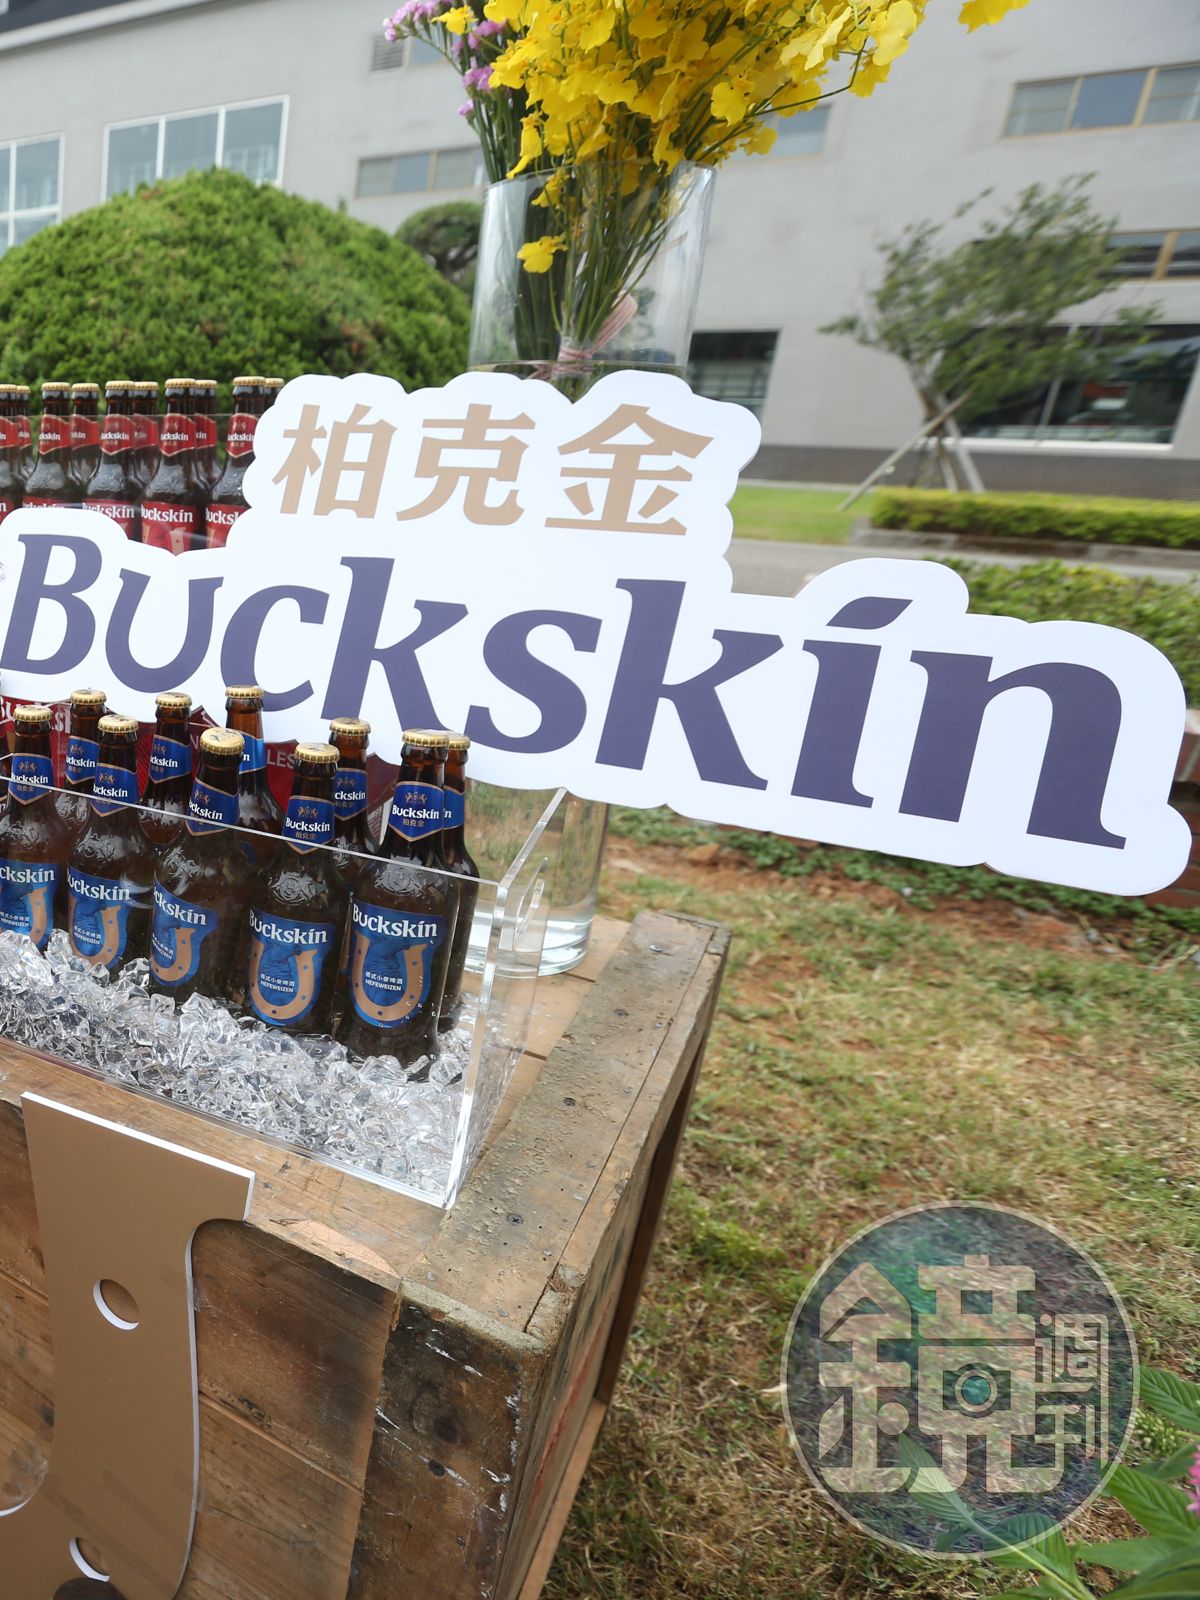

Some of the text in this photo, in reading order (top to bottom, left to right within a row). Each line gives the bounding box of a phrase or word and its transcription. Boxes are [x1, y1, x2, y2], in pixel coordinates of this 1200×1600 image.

[101, 432, 130, 441] uckskin
[160, 432, 189, 441] uckskin
[273, 405, 712, 536] 柏克金
[0, 533, 1128, 850] Buckskin
[335, 790, 366, 801] ckskin
[392, 804, 440, 820] Buckskin
[285, 816, 331, 832] Buckskin
[249, 909, 328, 945] Buckskin
[353, 903, 438, 939] Buckskin
